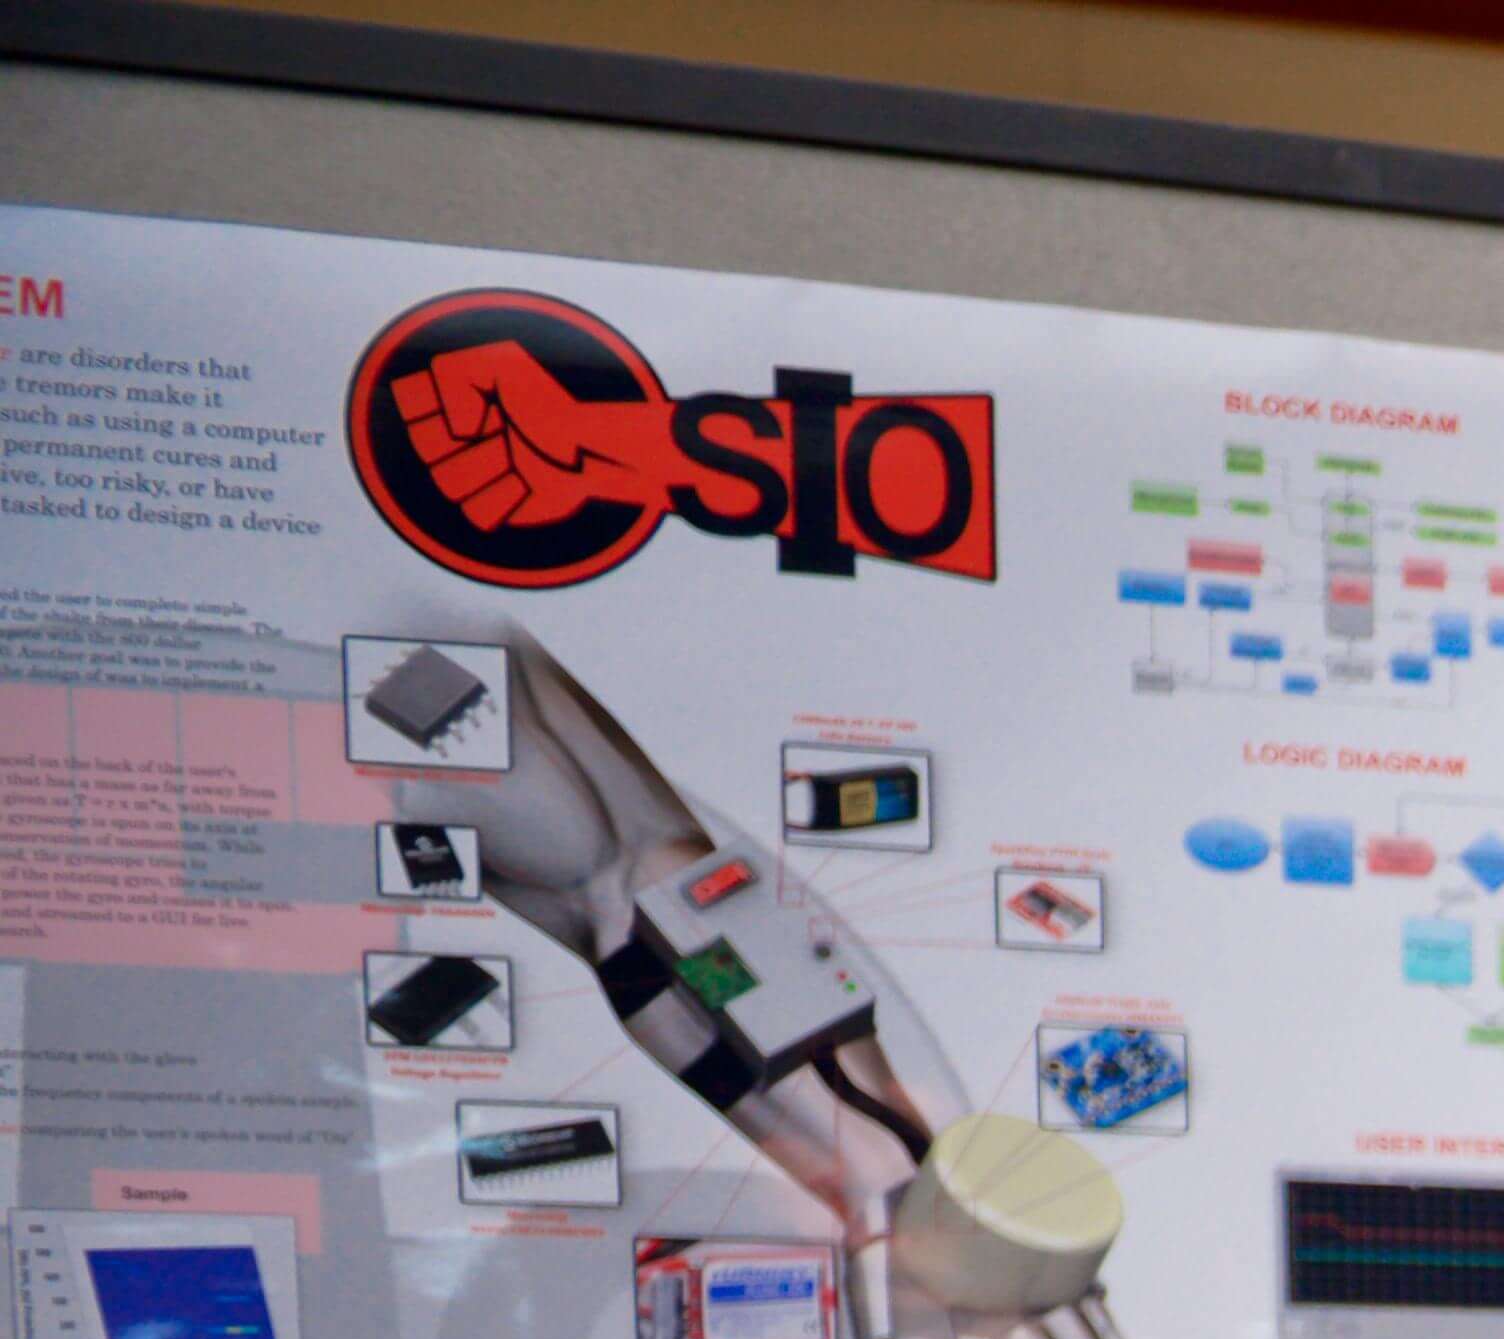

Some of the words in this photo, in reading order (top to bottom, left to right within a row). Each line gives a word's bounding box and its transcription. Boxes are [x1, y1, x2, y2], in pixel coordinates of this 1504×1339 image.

[20, 348, 63, 366] are
[70, 346, 190, 376] disorders
[197, 357, 251, 381] that
[16, 376, 117, 400] tremors
[127, 384, 197, 407] make
[205, 389, 224, 409] it
[1, 406, 58, 426] such
[67, 411, 95, 428] as
[104, 411, 174, 438] using
[182, 420, 197, 436] a
[204, 423, 326, 447] computer
[1224, 389, 1322, 420] BLOCK
[1329, 401, 1461, 436] DIAGRAM
[3, 437, 145, 463] permanent
[153, 449, 222, 470] cures
[229, 452, 278, 472] and
[54, 471, 94, 489] too
[179, 480, 206, 496] or
[213, 479, 275, 502] have
[0, 496, 87, 519] tasked
[95, 502, 120, 520] to
[128, 502, 211, 531] design
[219, 513, 234, 529] a
[242, 511, 321, 535] device
[1243, 740, 1329, 768] LOGIC
[1337, 749, 1468, 778] DIAGRAM
[1355, 1130, 1426, 1153] USER
[121, 1186, 188, 1202] Sample
